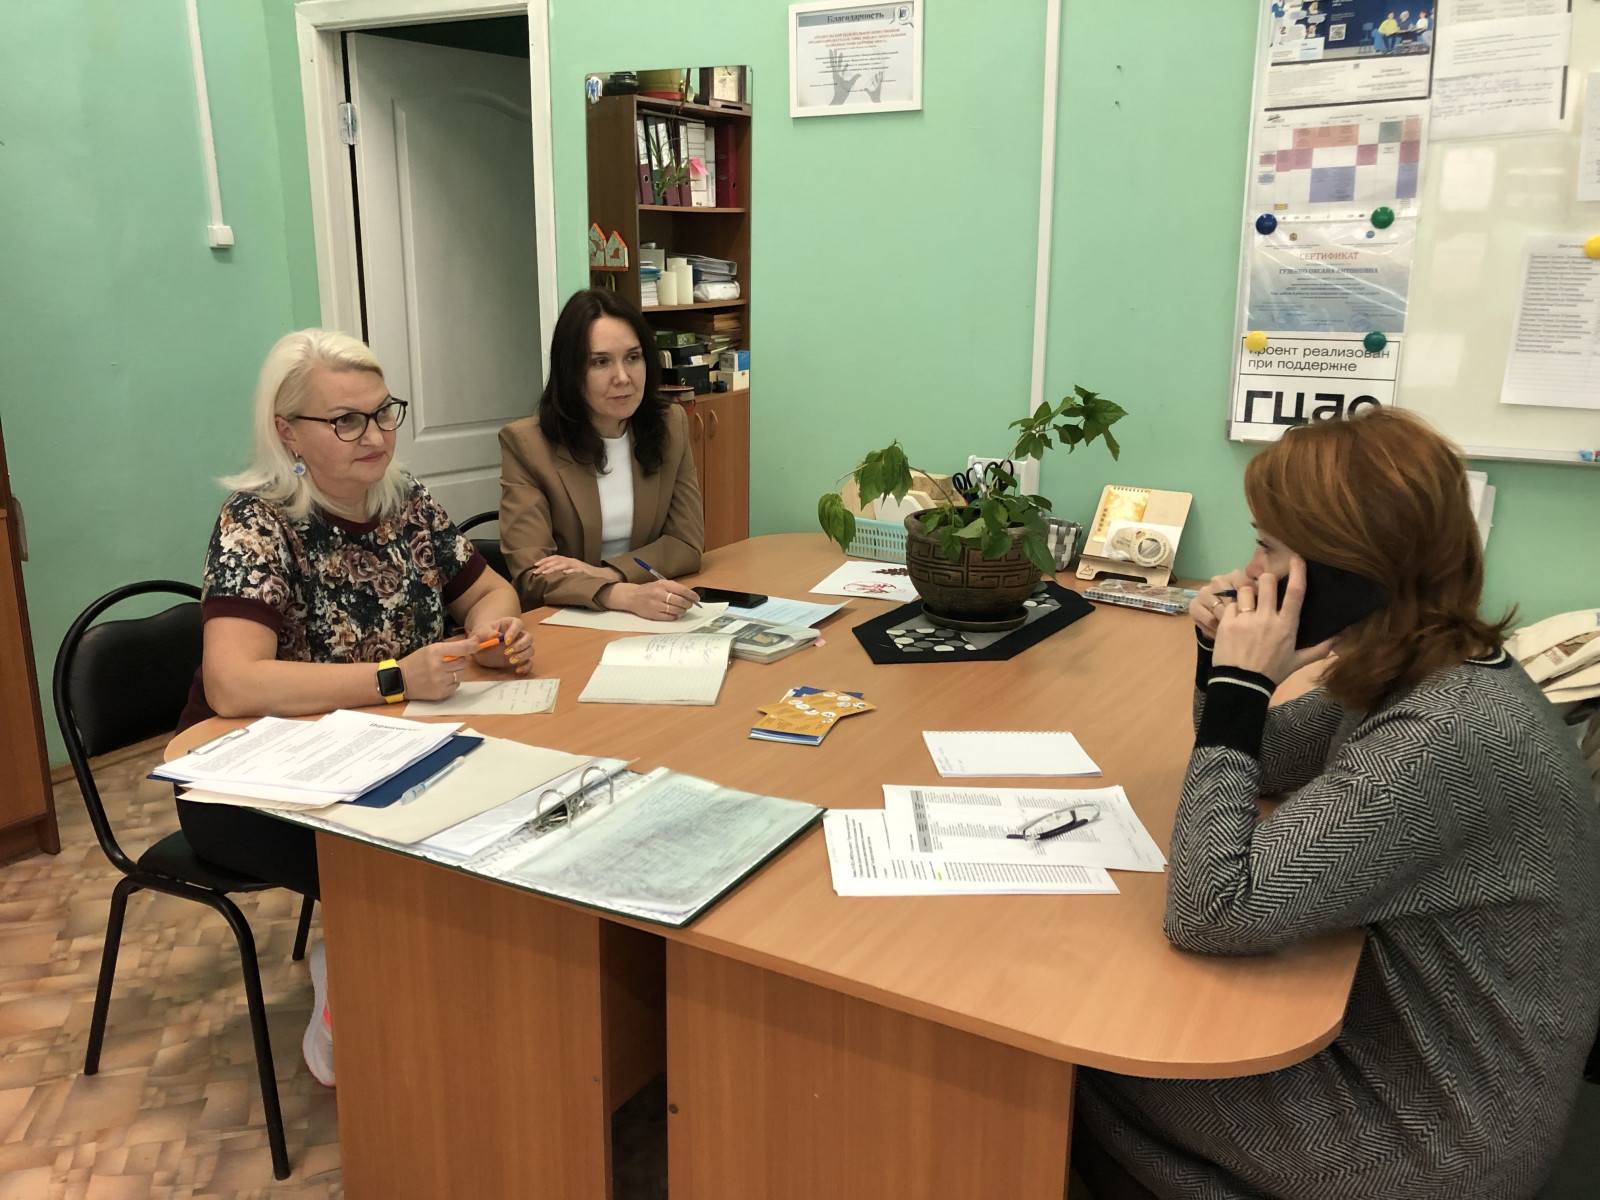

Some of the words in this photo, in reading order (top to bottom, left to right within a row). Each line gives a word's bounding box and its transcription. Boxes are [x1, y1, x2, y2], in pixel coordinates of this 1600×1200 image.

[827, 11, 884, 24] Благодарность
[1299, 252, 1360, 261] СЕРТИФИКАТ
[1302, 347, 1390, 359] реализован
[1248, 359, 1273, 370] при
[1277, 360, 1357, 373] поддержке
